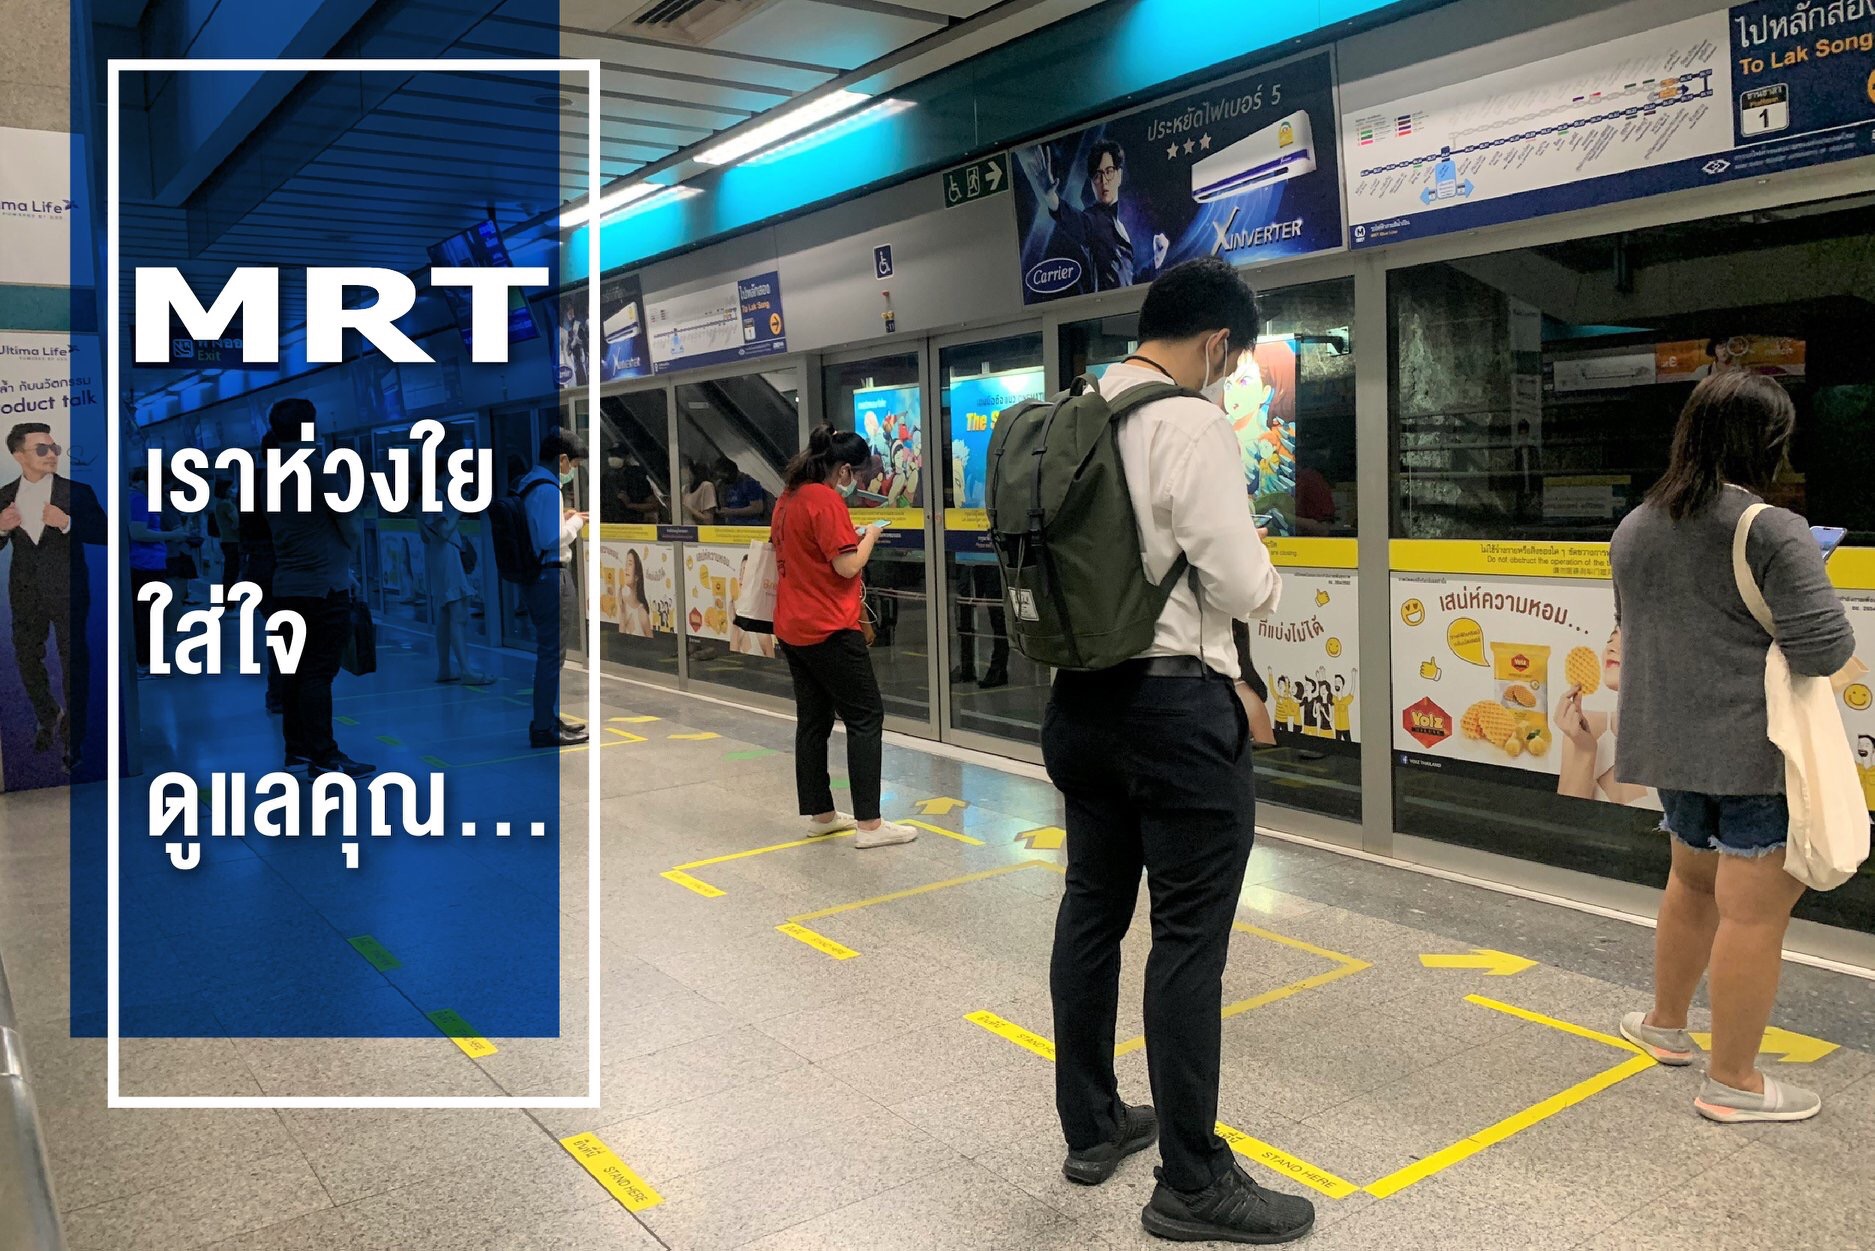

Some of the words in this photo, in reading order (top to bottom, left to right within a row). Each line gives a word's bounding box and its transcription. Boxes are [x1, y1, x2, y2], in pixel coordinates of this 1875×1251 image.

[1739, 57, 1764, 76] To
[1771, 46, 1809, 69] Lak
[1815, 32, 1873, 58] Song
[1147, 84, 1263, 142] ประหยัดไฟเบอร์
[1271, 84, 1281, 106] 5
[1759, 108, 1769, 128] 1
[1, 201, 28, 212] ma
[32, 200, 63, 213] Life
[1032, 265, 1075, 285] Carrier
[42, 346, 67, 356] Life
[197, 350, 221, 361] Exit
[19, 376, 91, 392] กับนวัตกรรม
[1, 396, 55, 414] oduct
[62, 389, 96, 408] talk
[966, 412, 987, 431] The
[1487, 555, 1496, 563] Do
[1509, 556, 1536, 564] obstruct
[1551, 558, 1583, 566] operation
[1584, 558, 1591, 566] of
[1016, 1033, 1046, 1048] STAND
[1261, 1151, 1303, 1173] STAND
[1301, 1171, 1337, 1189] HERE
[603, 1165, 631, 1187] STAND
[623, 1184, 648, 1203] HERE
